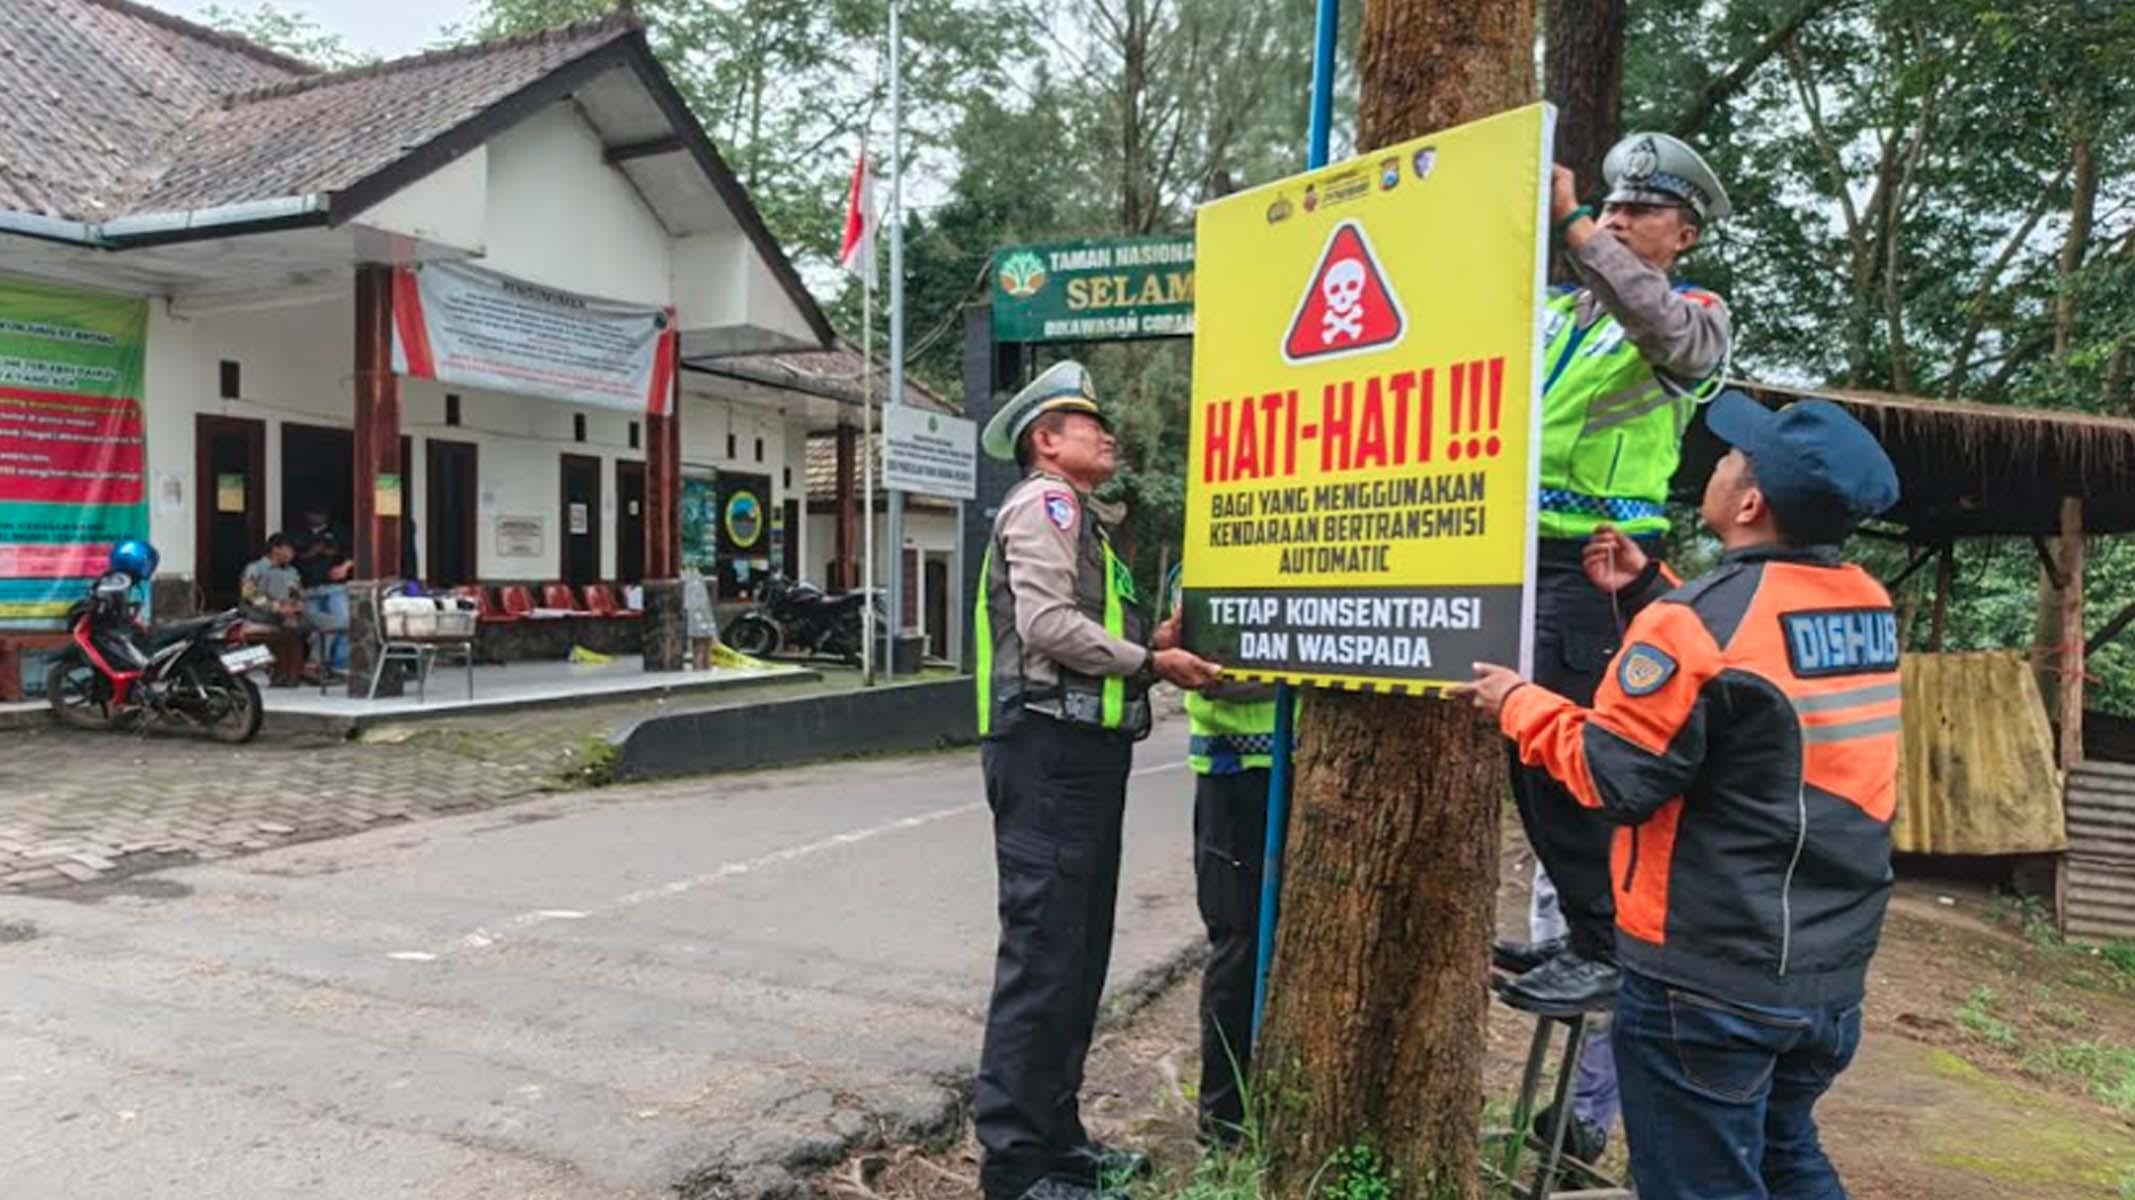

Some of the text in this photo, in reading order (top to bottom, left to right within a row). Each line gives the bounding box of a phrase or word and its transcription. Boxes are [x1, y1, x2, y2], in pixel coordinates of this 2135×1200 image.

[1051, 248, 1111, 271] TAMAN
[1067, 271, 1195, 311] SELAM
[1203, 357, 1504, 484] HATI-HATI !!!
[1211, 471, 1485, 519] BAGI YANG MENGGUNAKAN
[1210, 506, 1485, 547] KENDARAAN BERTRANSMISI
[1278, 545, 1391, 574] AUTOMATIC
[1209, 597, 1481, 629] TETAP KONSENTRASI
[1240, 632, 1431, 668] DAN WASPADA
[1791, 612, 1898, 669] DISHUB
